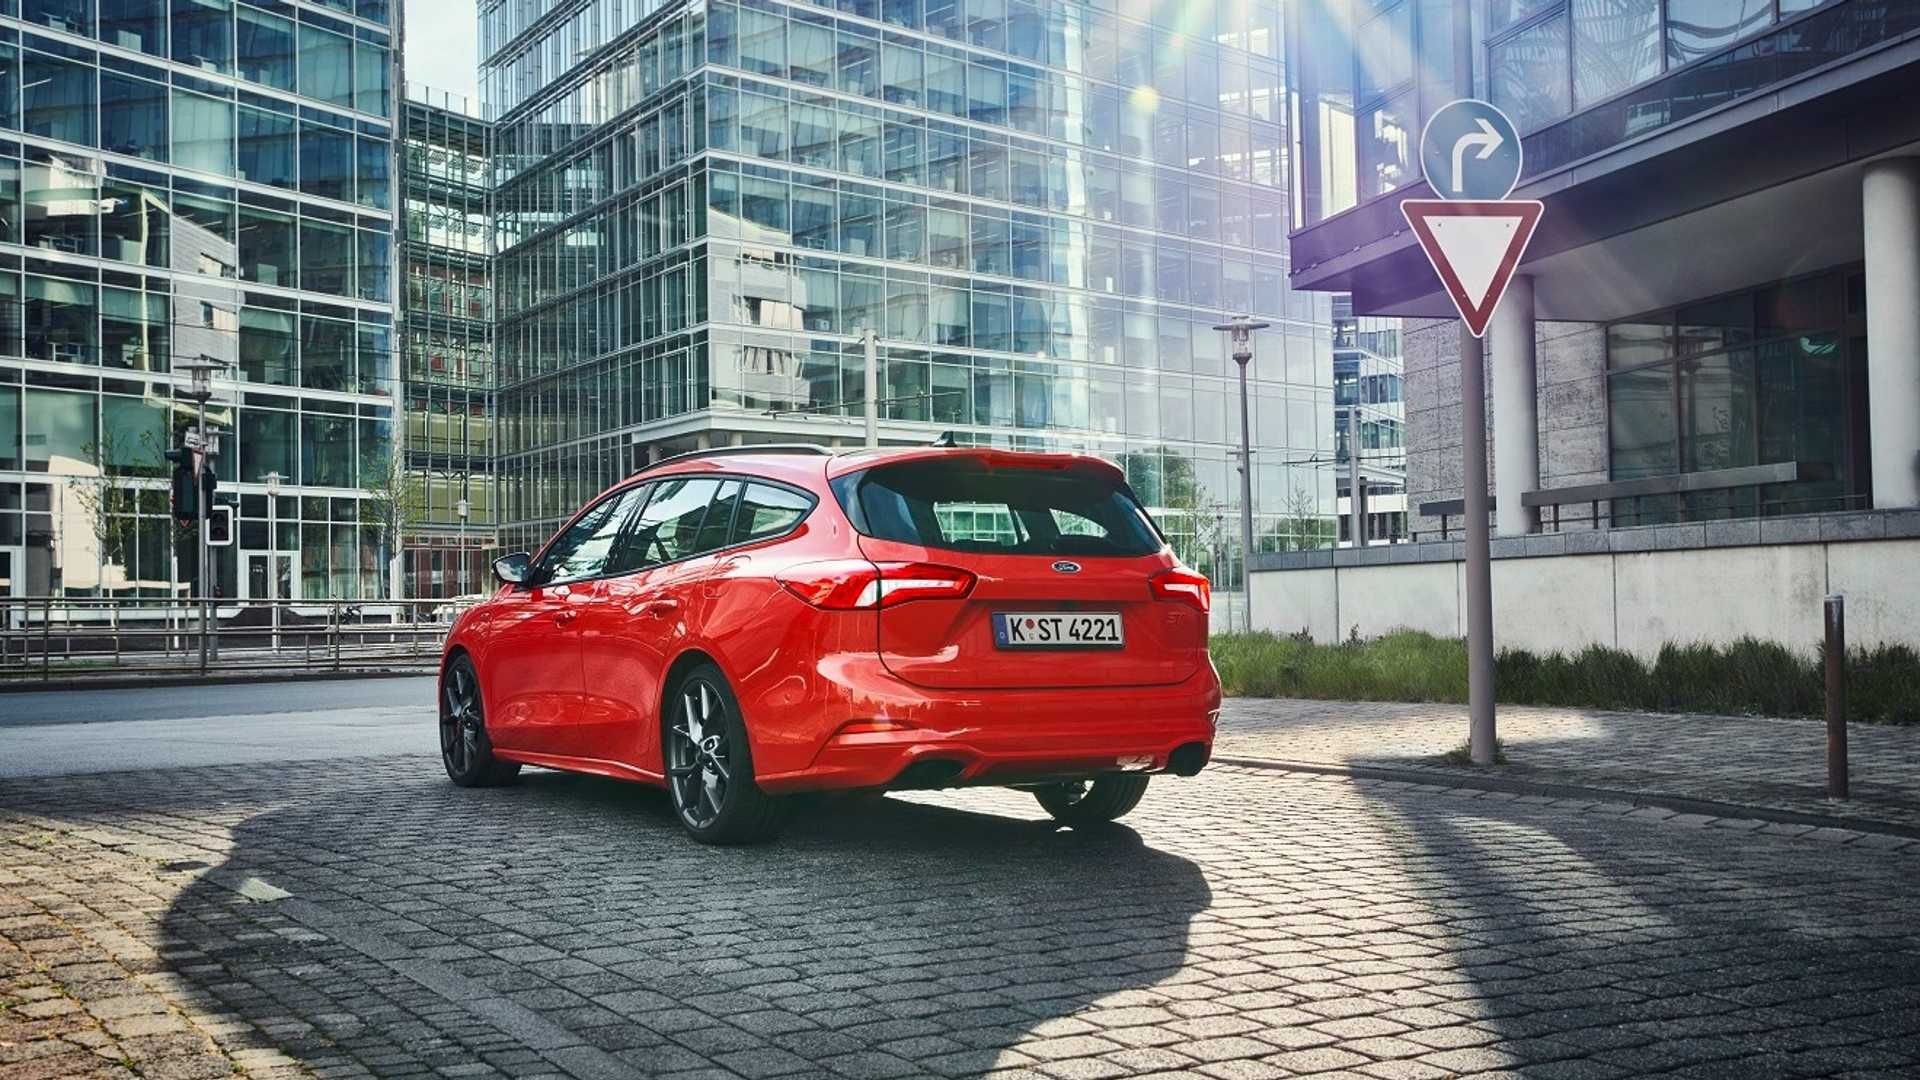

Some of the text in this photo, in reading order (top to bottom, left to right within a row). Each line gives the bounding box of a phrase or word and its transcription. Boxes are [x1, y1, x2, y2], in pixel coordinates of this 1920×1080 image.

[1055, 562, 1077, 571] Ford
[1009, 617, 1119, 641] K ST 4221
